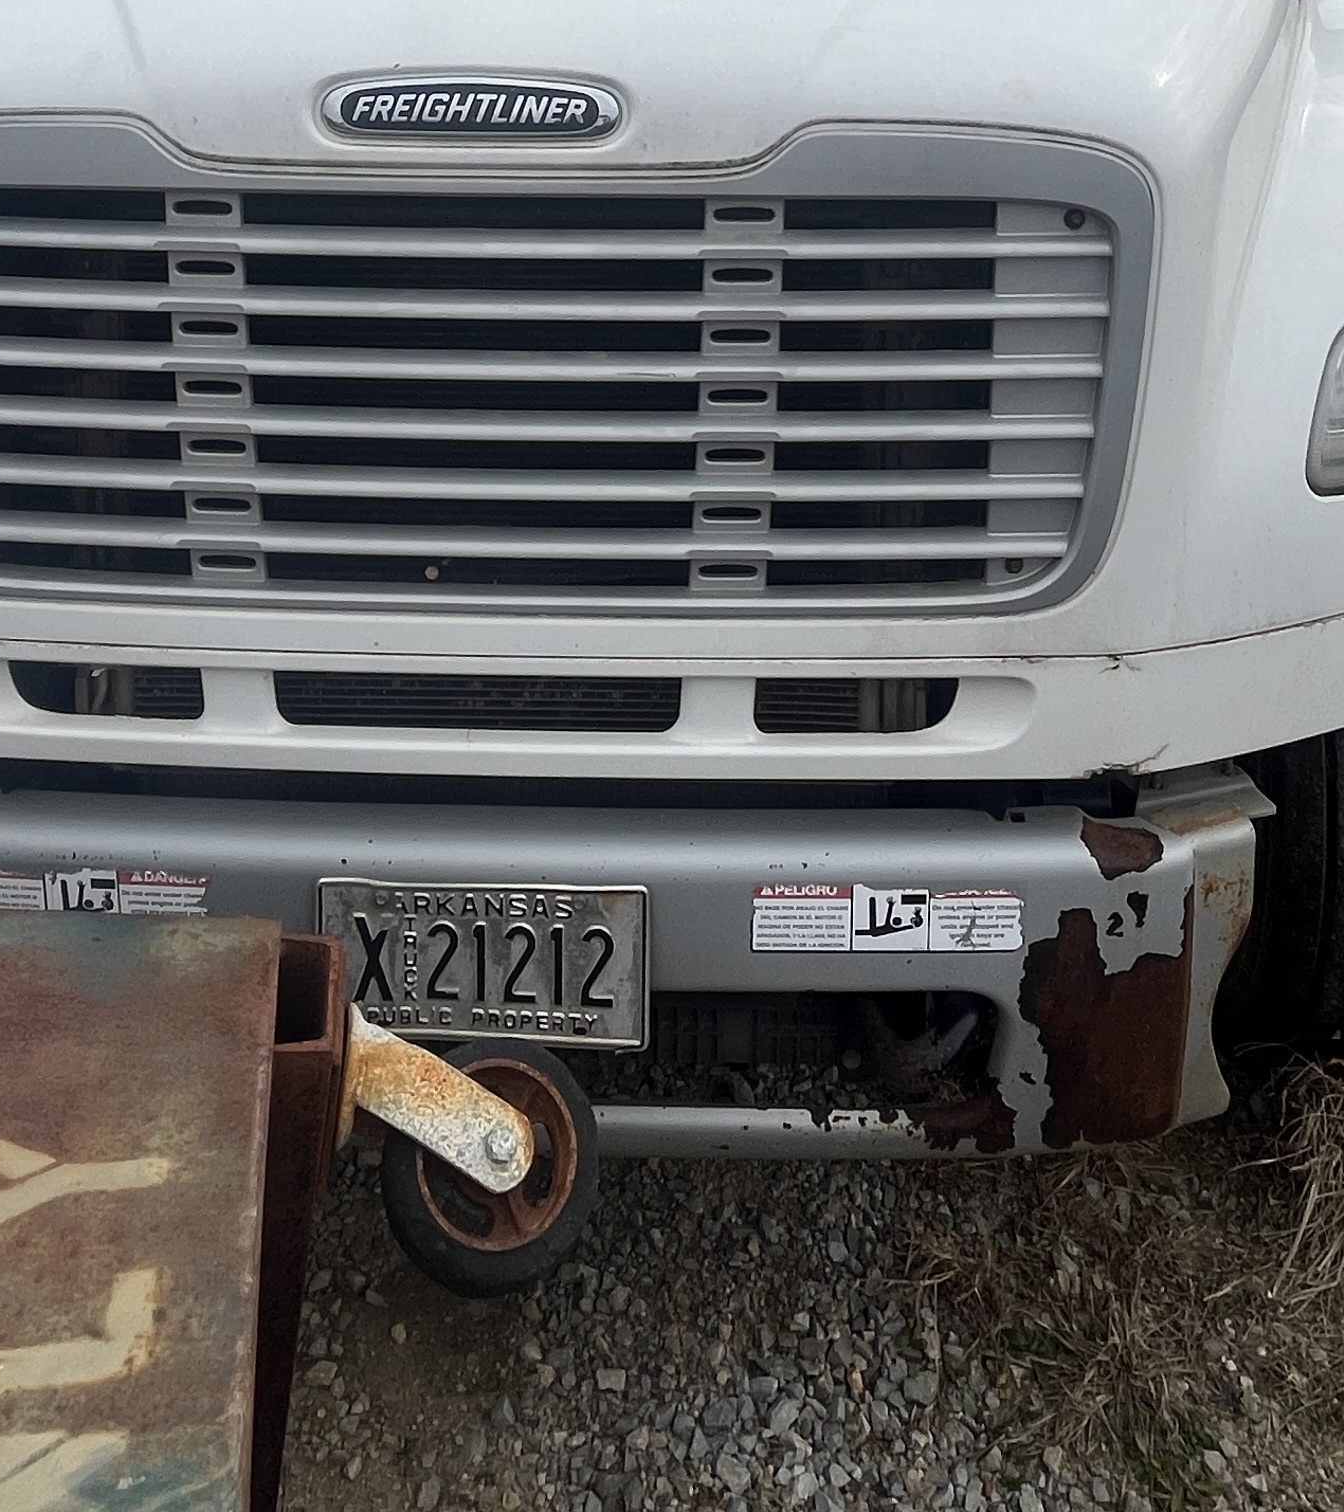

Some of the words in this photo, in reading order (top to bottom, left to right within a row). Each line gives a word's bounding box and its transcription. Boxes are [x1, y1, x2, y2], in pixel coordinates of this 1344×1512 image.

[351, 92, 587, 125] FREIGHTLINER
[394, 891, 574, 919] ARKANSAS
[352, 912, 394, 1003] X
[426, 919, 616, 1008] 21212
[402, 915, 419, 1001] TRUCK
[367, 1004, 453, 1026] PUBLIC
[470, 1006, 599, 1033] PROPERTY
